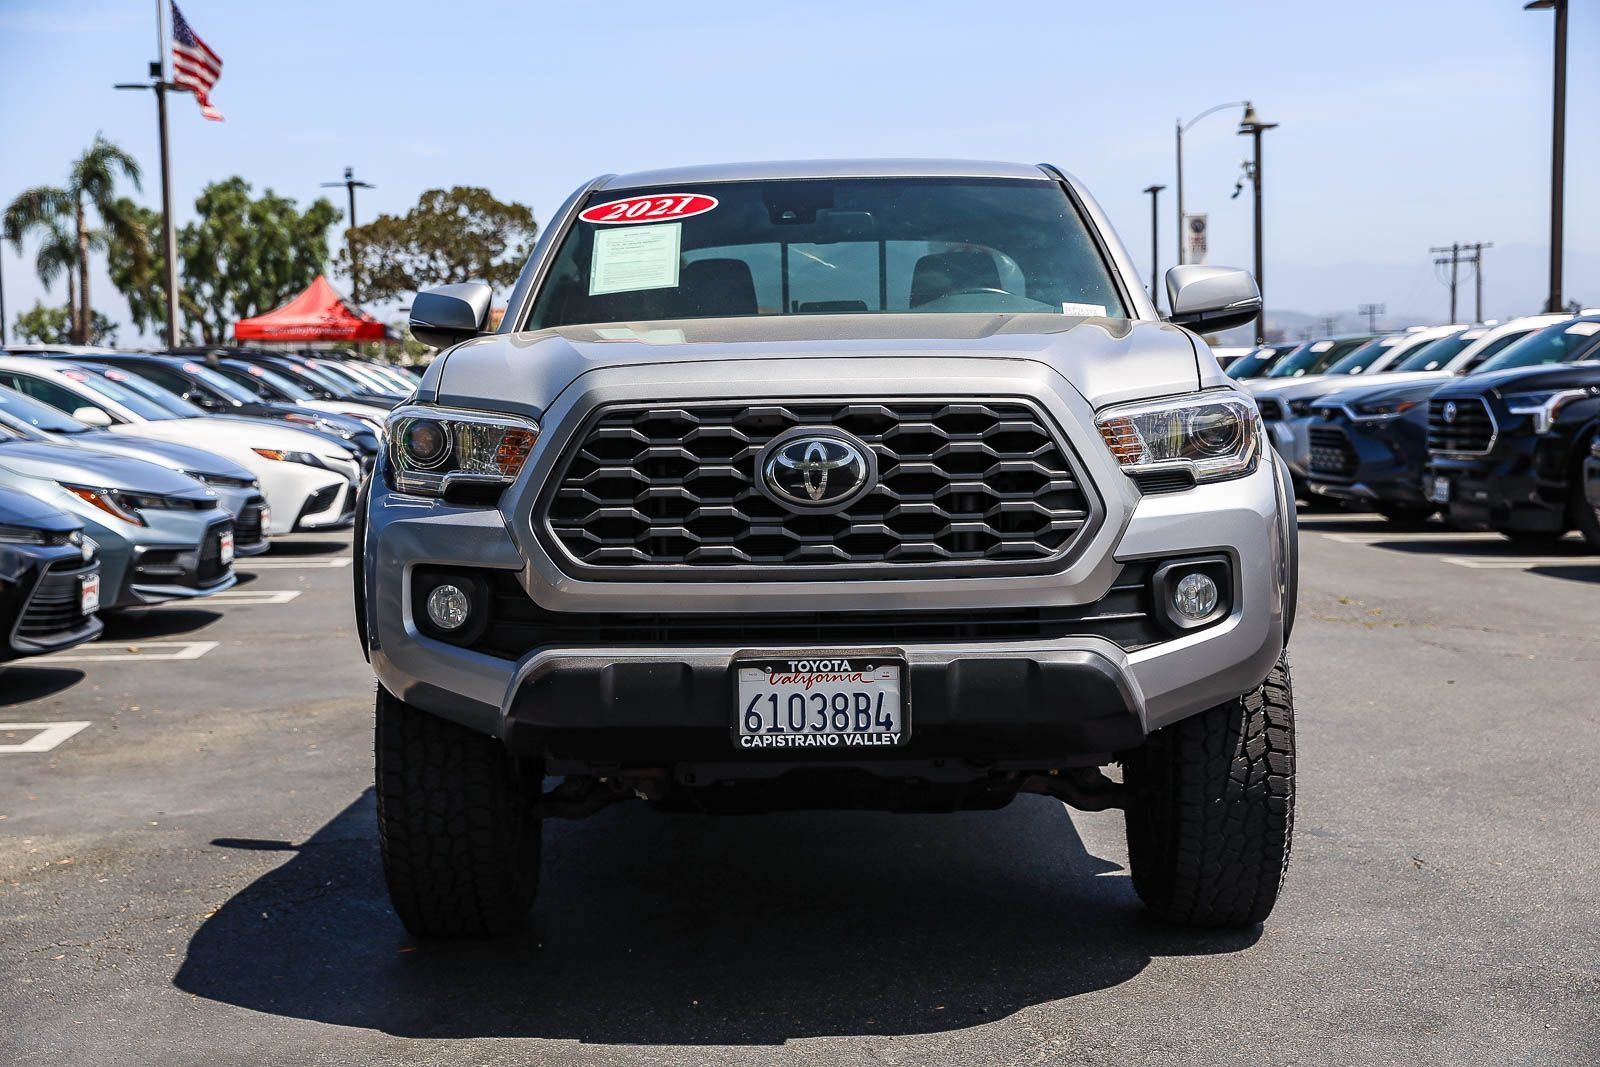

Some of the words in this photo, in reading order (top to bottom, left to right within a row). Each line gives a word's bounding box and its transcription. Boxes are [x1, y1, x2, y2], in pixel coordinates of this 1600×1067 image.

[601, 197, 695, 221] 2021
[788, 660, 852, 673] TOYOTA
[769, 672, 875, 690] California
[744, 691, 894, 733] 61038B4
[740, 734, 839, 748] CAPISTRANO
[842, 733, 902, 746] VALLEY
